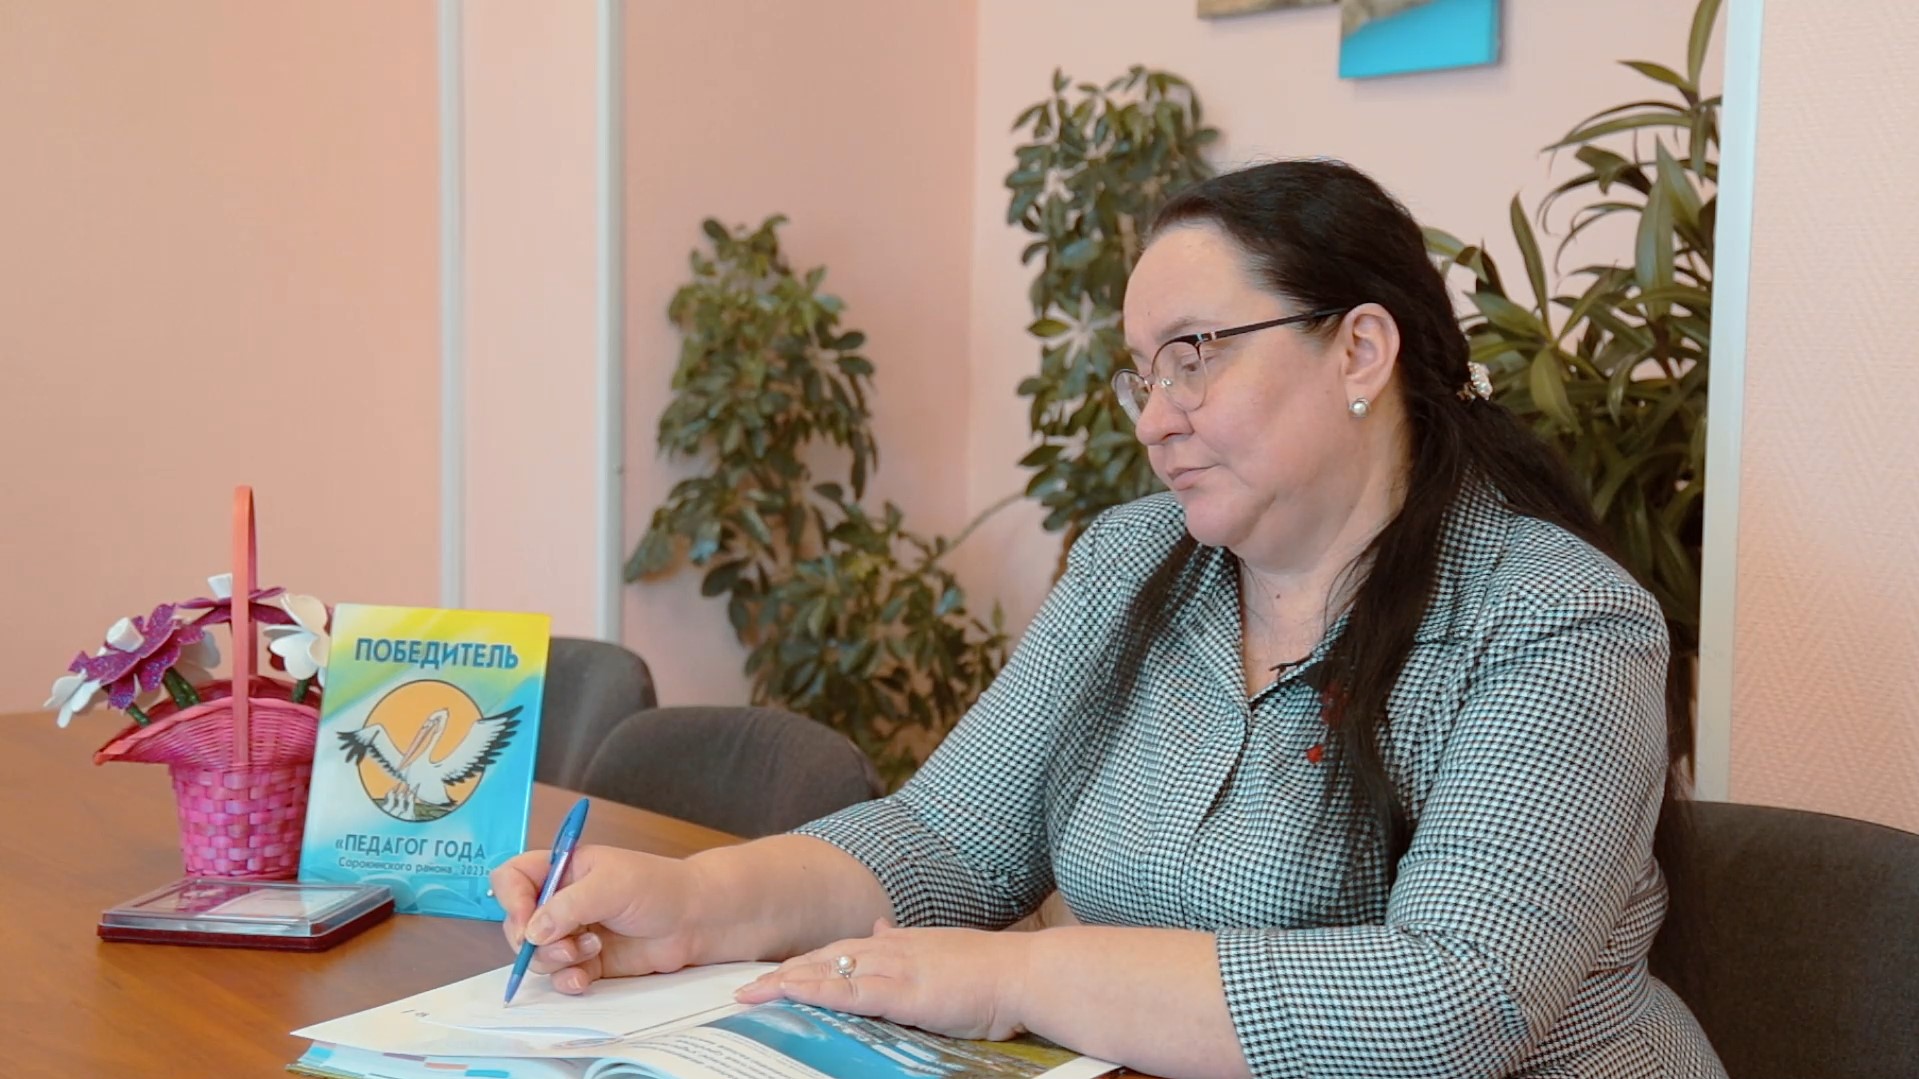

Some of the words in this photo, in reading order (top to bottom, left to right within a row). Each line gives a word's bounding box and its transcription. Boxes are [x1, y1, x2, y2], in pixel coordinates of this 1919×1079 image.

[355, 637, 519, 670] ПОБЕДИТЕЛЬ
[335, 834, 428, 857] «ПЕДАГОГ
[434, 840, 487, 862] ГОДА
[338, 857, 412, 873] Сорокинского
[415, 860, 453, 874] района
